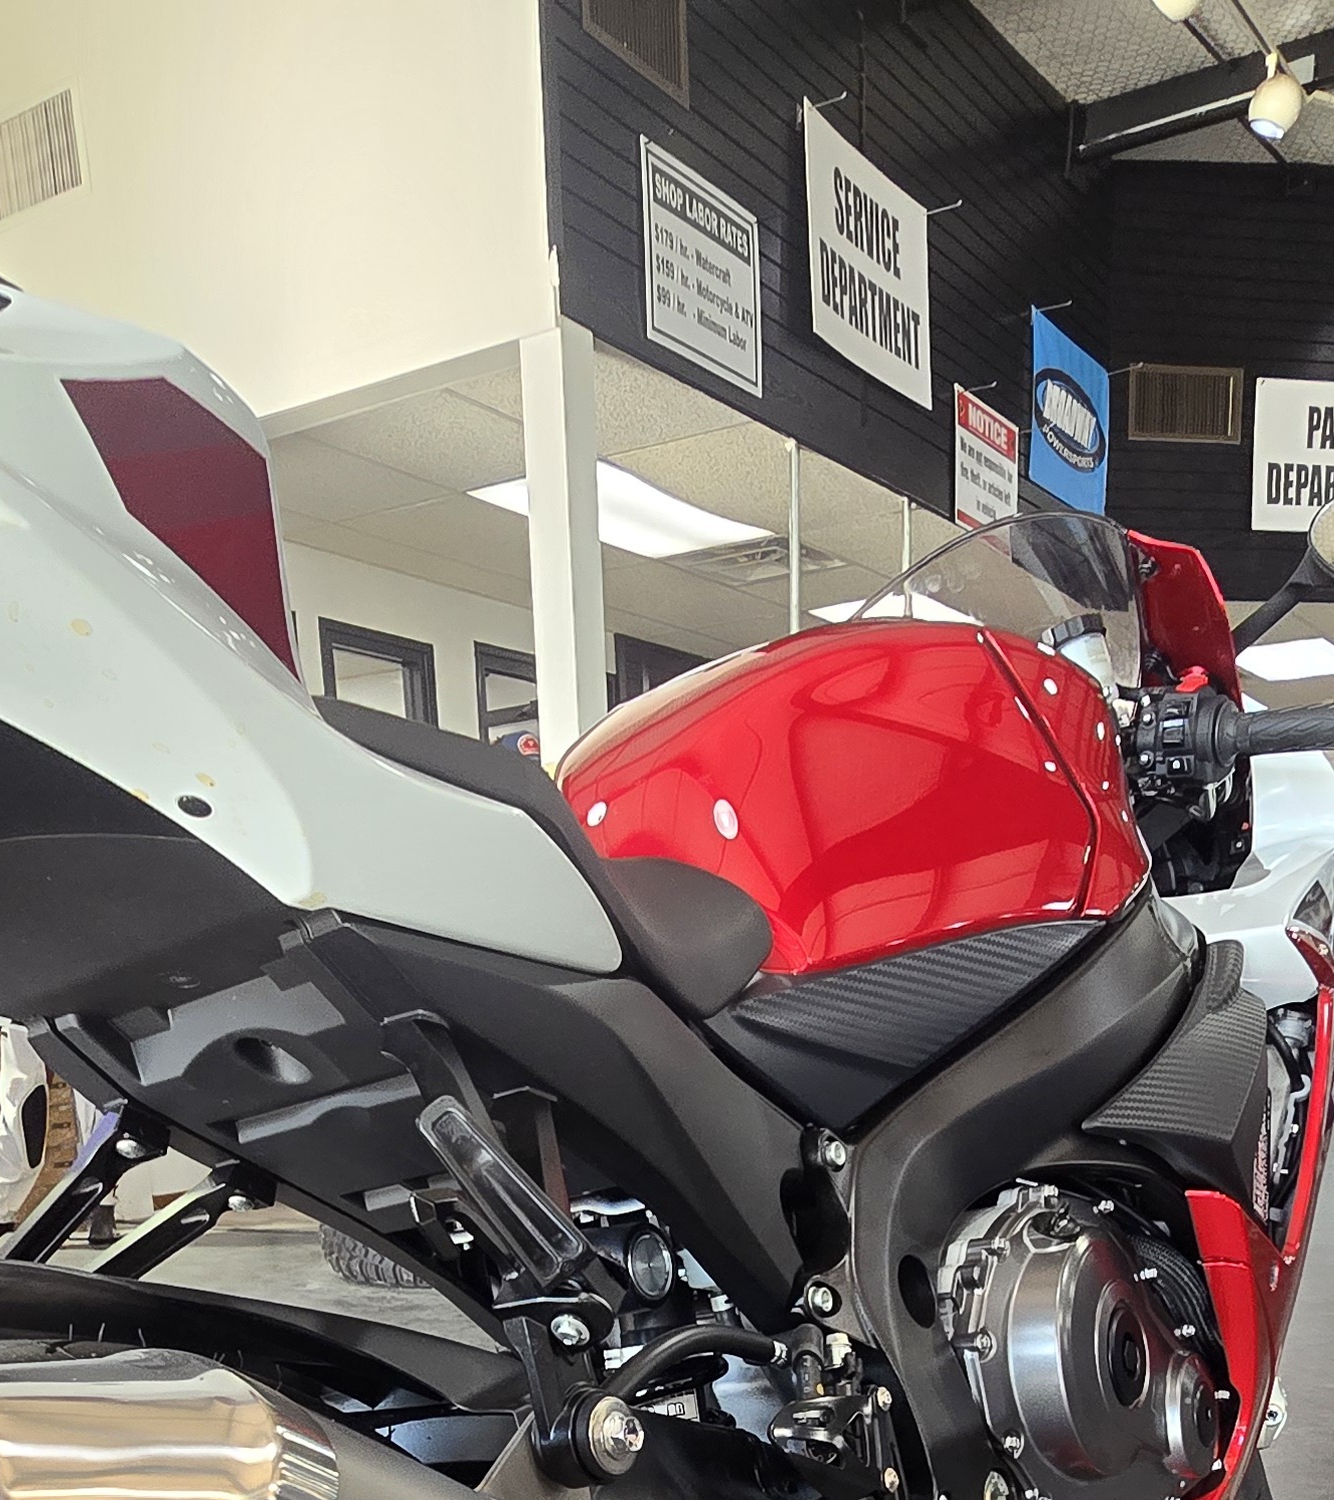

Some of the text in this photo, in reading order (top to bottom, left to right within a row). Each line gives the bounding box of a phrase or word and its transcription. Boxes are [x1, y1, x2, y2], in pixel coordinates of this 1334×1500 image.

[654, 172, 748, 258] SHOP LABOR RATES
[833, 166, 901, 281] SERVICE
[654, 222, 673, 251] $179
[695, 247, 731, 288] Watercraft
[655, 253, 674, 280] $159
[695, 278, 733, 321] Motorcycle
[741, 307, 754, 329] ATV
[696, 308, 727, 340] Minimum
[728, 324, 747, 352] Labor
[818, 237, 921, 370] DEPARTMENT
[967, 402, 1008, 450] NOTICE
